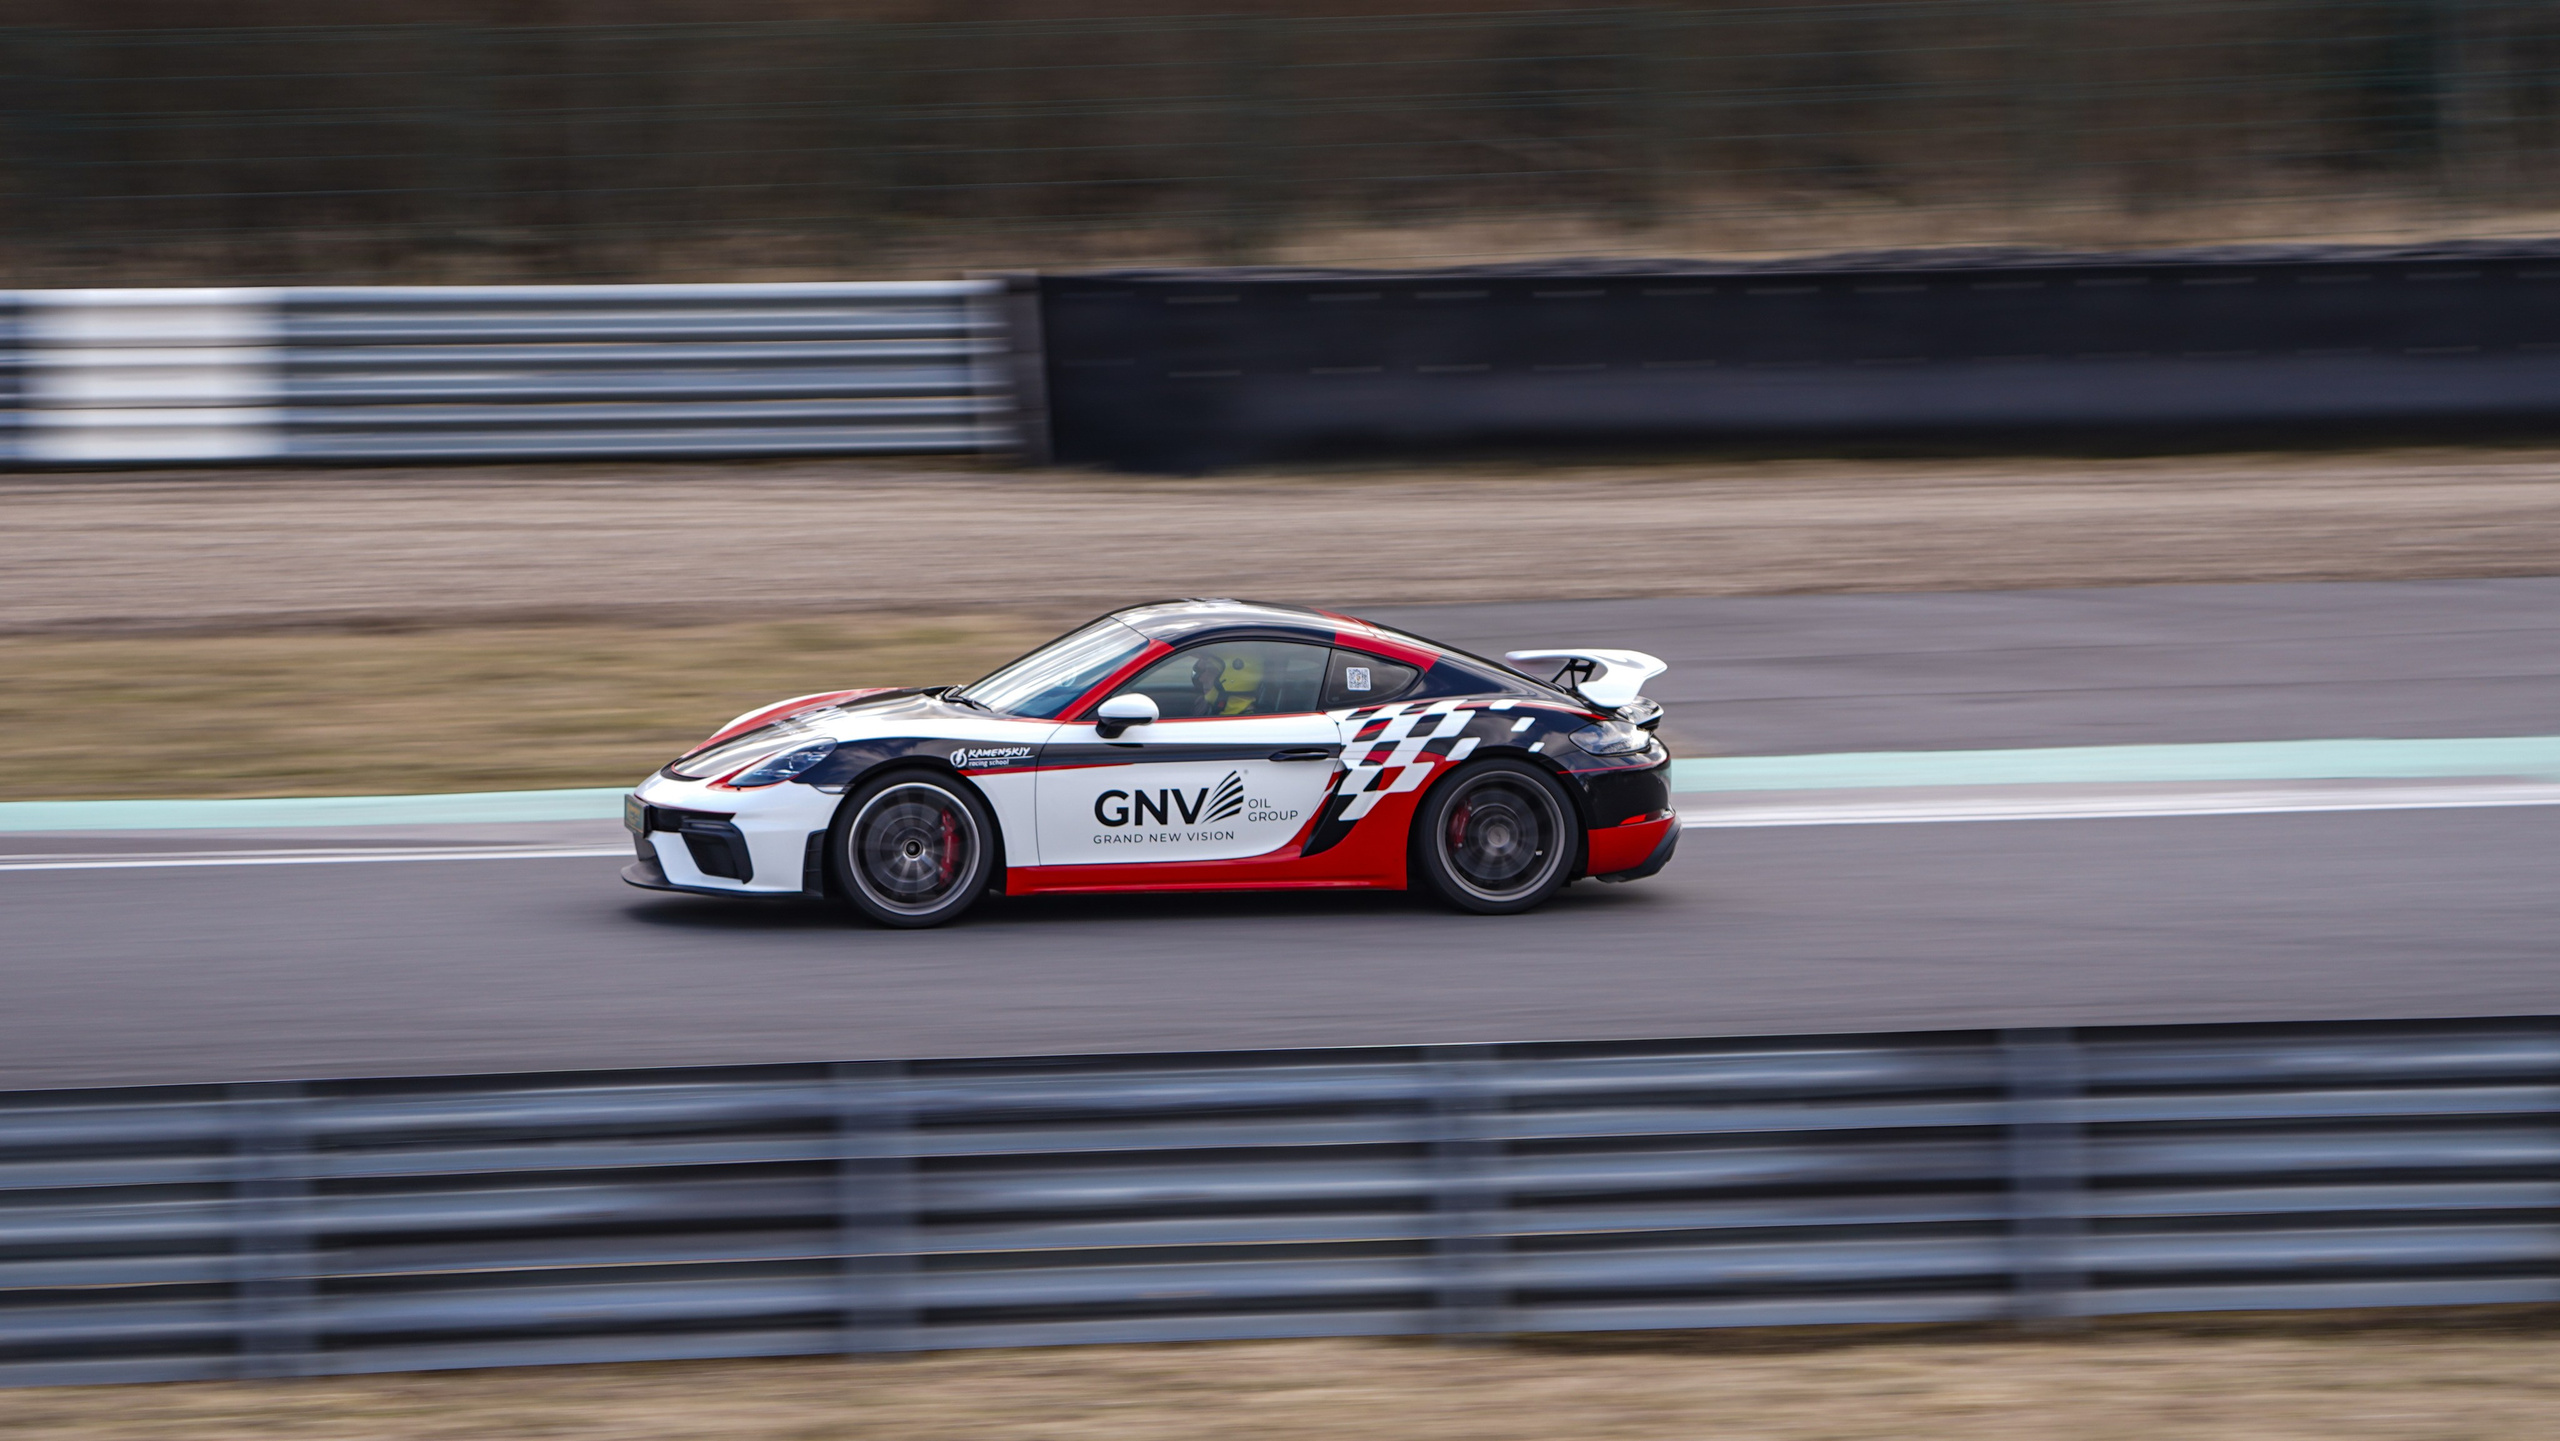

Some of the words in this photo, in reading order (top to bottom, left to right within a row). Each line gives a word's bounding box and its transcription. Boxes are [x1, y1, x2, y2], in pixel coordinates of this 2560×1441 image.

[968, 747, 1031, 758] KAMENSKIY
[968, 760, 988, 768] racing
[1094, 787, 1210, 827] GNV
[1248, 798, 1271, 809] OIL
[1248, 810, 1299, 822] GROUP
[1093, 834, 1144, 845] GRAND
[1149, 832, 1182, 843] NEW
[1186, 831, 1234, 842] VISION
